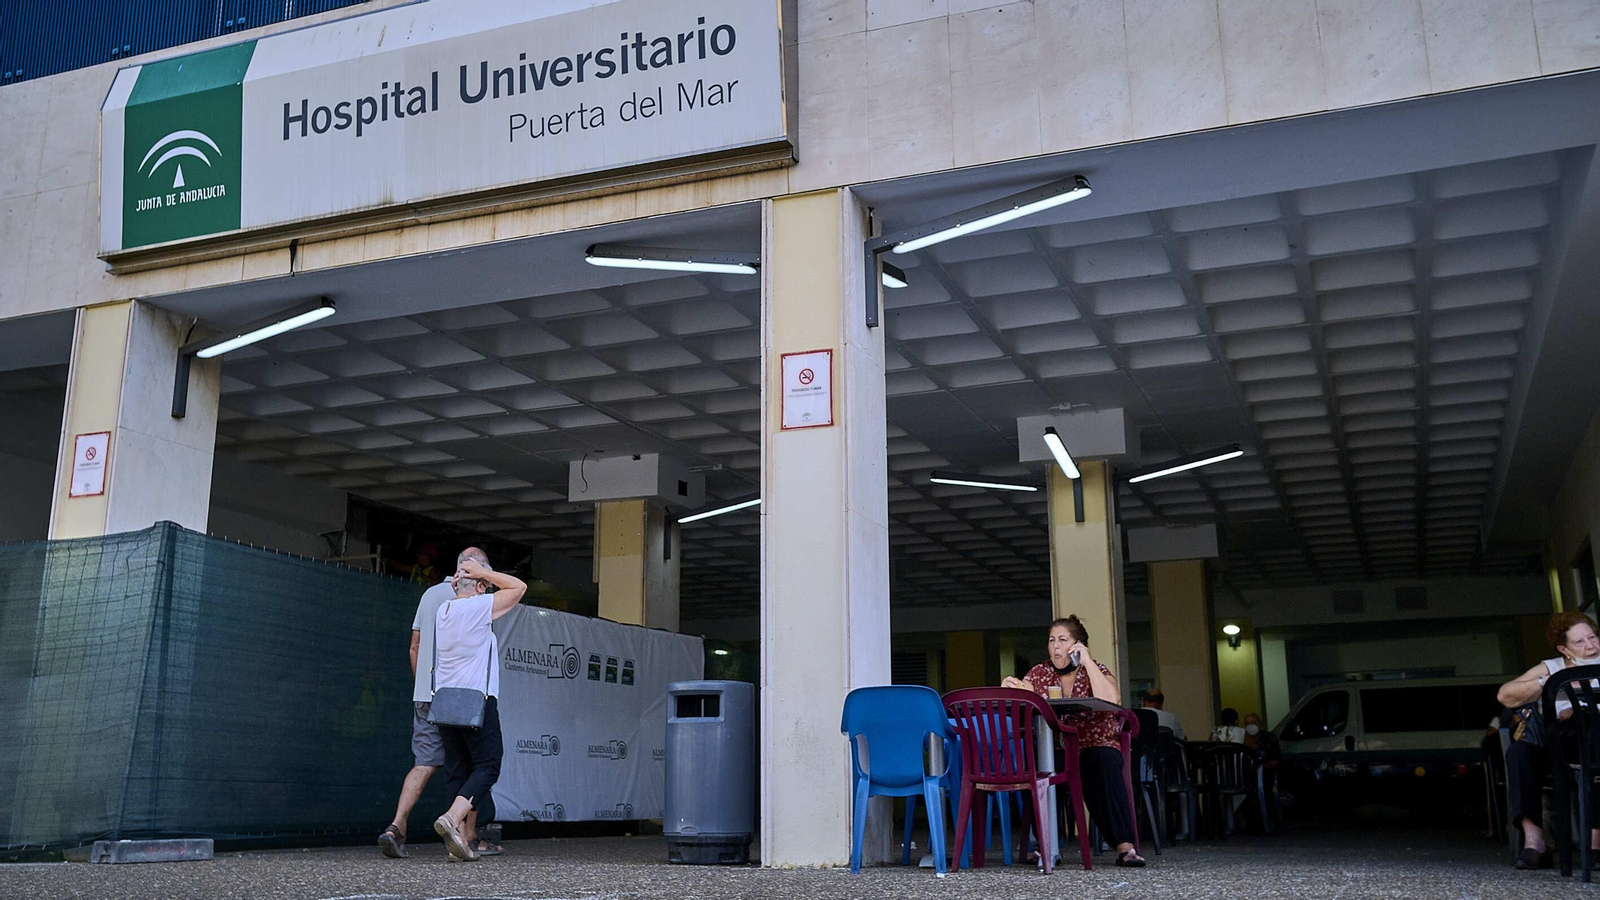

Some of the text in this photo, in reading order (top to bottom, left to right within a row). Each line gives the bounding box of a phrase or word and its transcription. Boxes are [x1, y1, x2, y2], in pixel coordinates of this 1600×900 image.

[283, 16, 737, 141] Hospital Universitario
[509, 79, 739, 143] Puerta del Mar
[135, 184, 226, 212] JUNTA DE ANDALUCIA
[505, 647, 559, 668] ALMENARA
[515, 739, 548, 750] ALMENARA
[587, 745, 617, 754] ALMENARA
